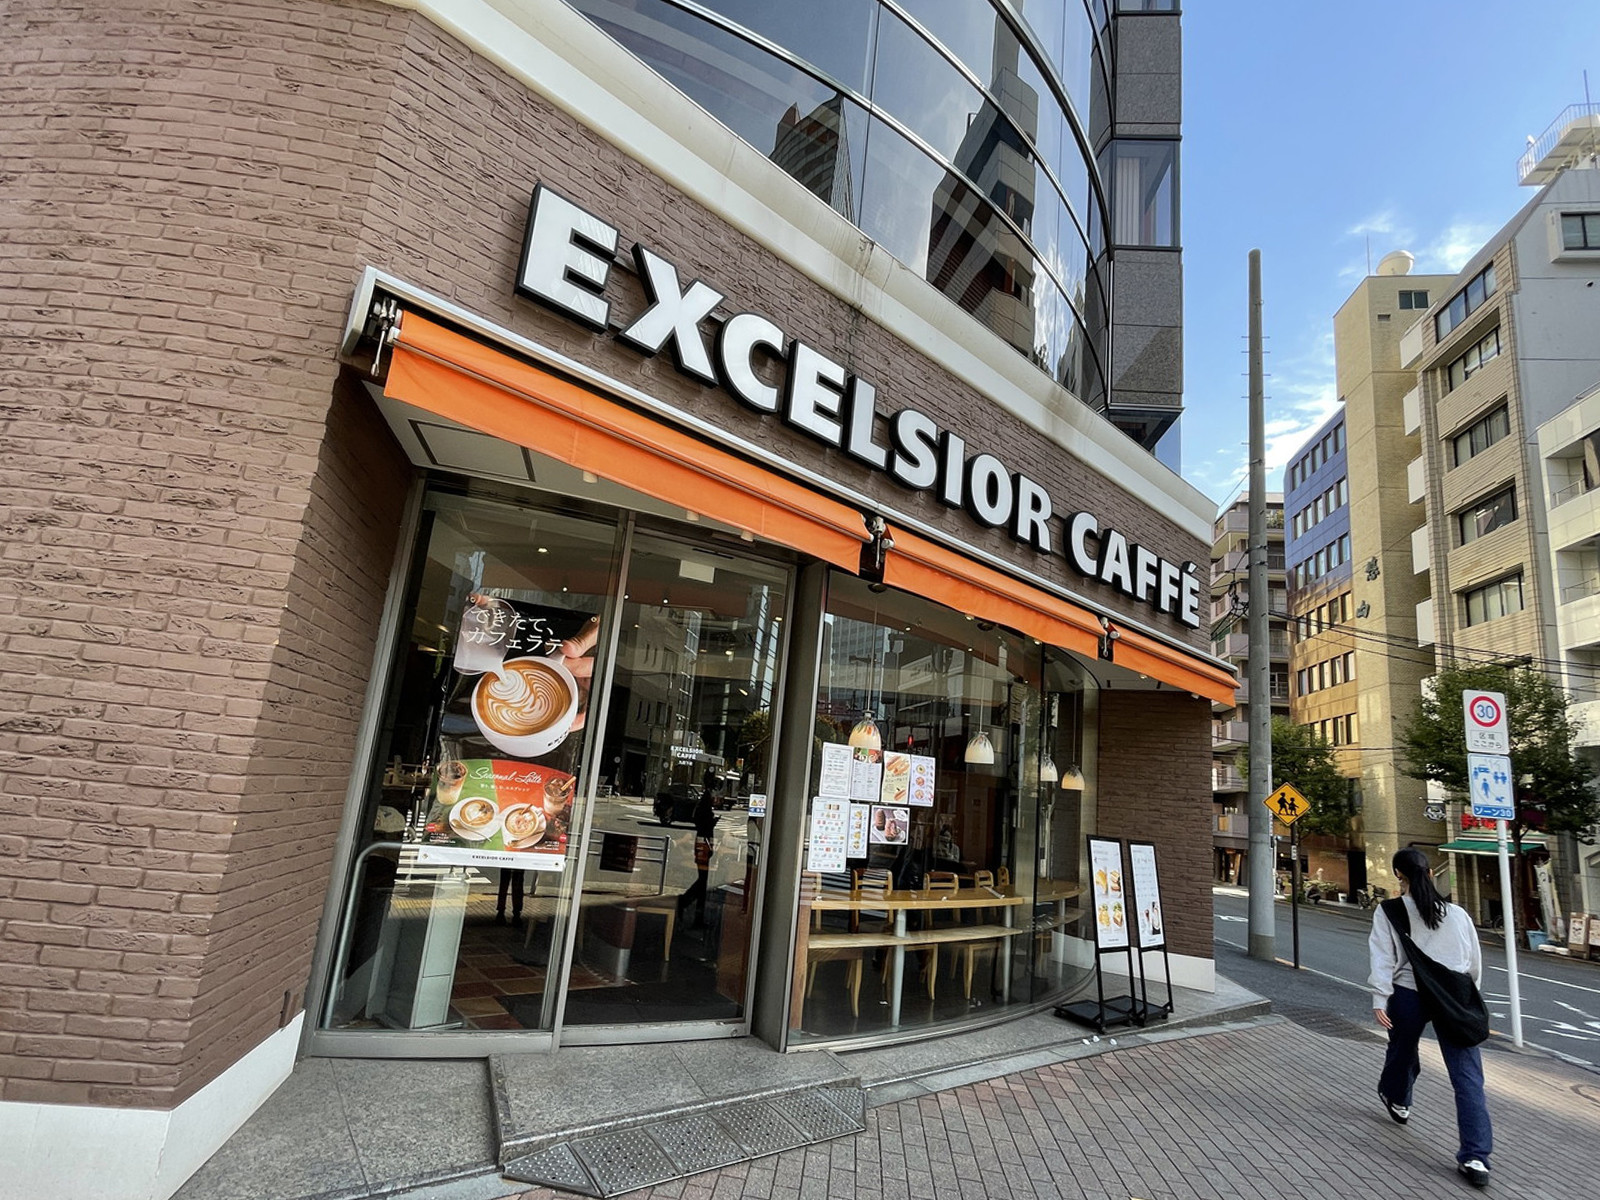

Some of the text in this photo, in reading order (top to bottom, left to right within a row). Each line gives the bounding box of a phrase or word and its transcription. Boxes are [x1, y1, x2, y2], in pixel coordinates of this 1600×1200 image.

[516, 182, 1200, 629] EXCELSIOR CAFFÉ
[470, 607, 554, 636] できたて、
[466, 626, 563, 655] カフェラテ
[1476, 704, 1495, 719] 30
[671, 746, 704, 754] EXCELSIOR
[1473, 740, 1502, 748] ここから
